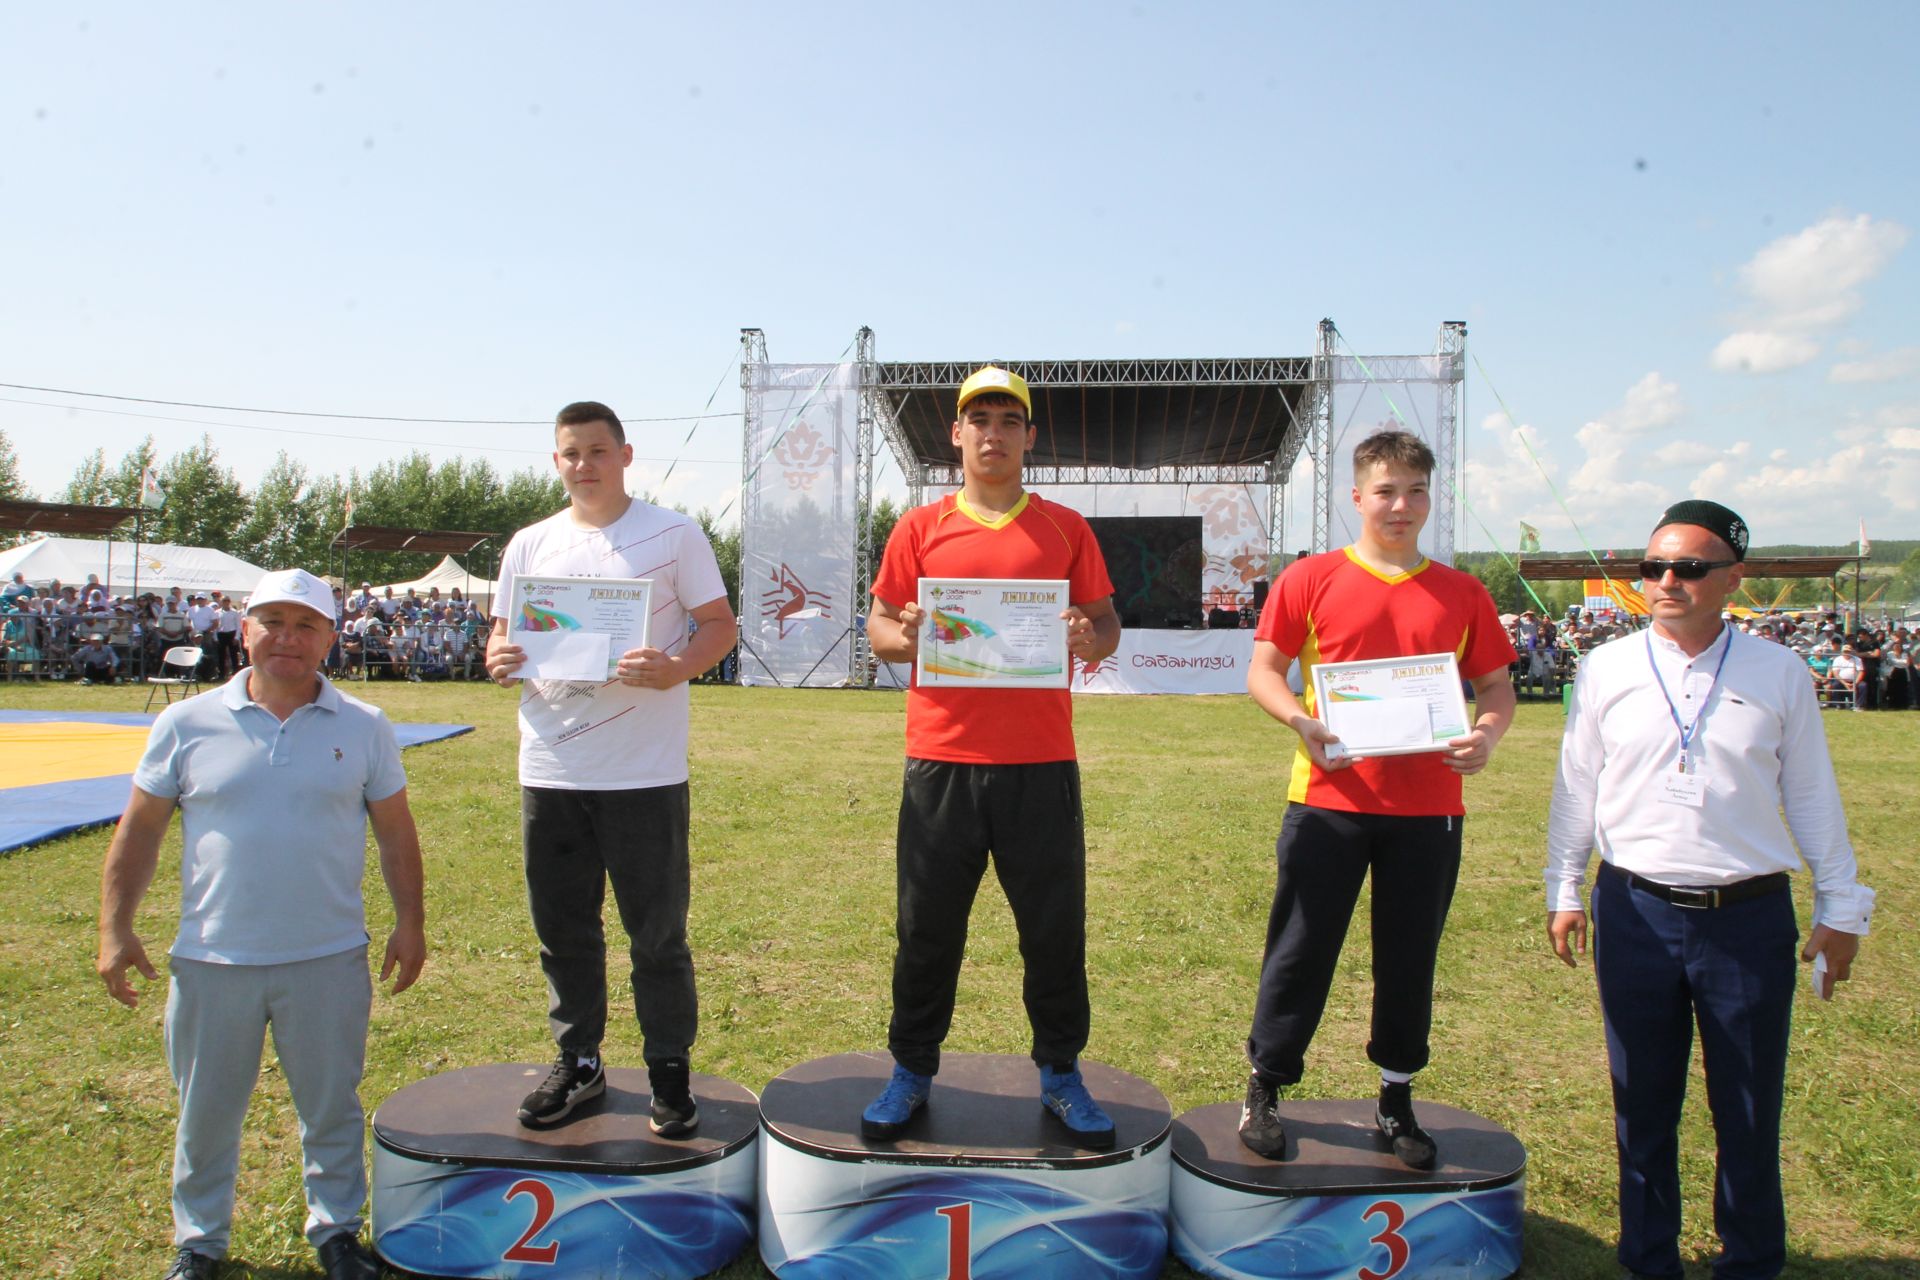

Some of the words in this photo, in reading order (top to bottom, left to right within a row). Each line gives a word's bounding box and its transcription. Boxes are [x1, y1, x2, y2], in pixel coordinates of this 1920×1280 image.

[588, 588, 642, 600] ДИПЛОМ
[1000, 591, 1057, 605] ДИПЛОМ
[1132, 654, 1235, 671] Сабантуй
[1392, 664, 1445, 681] ДИПЛОМ
[503, 1178, 560, 1265] 2
[935, 1201, 973, 1280] 1
[1357, 1200, 1410, 1280] 3
